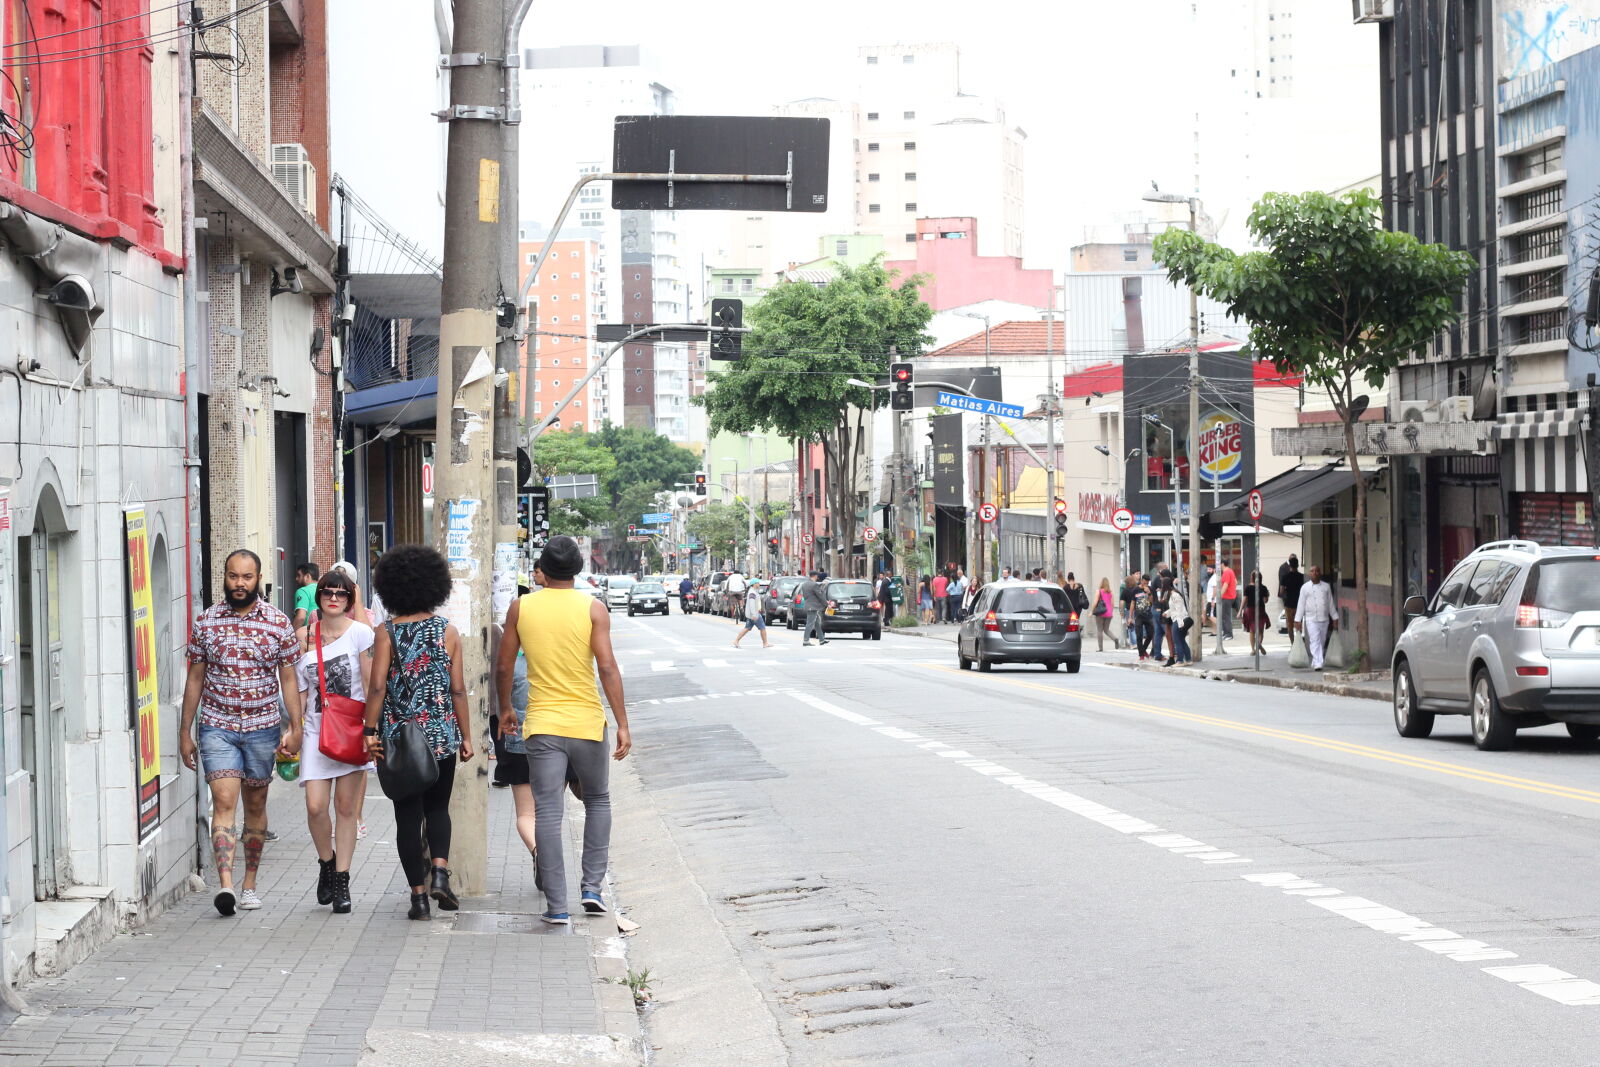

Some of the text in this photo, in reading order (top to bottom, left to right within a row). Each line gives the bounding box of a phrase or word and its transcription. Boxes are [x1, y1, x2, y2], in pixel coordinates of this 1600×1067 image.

[940, 394, 1021, 417] Matias Aires
[1199, 423, 1241, 447] URER
[1199, 435, 1242, 467] KING
